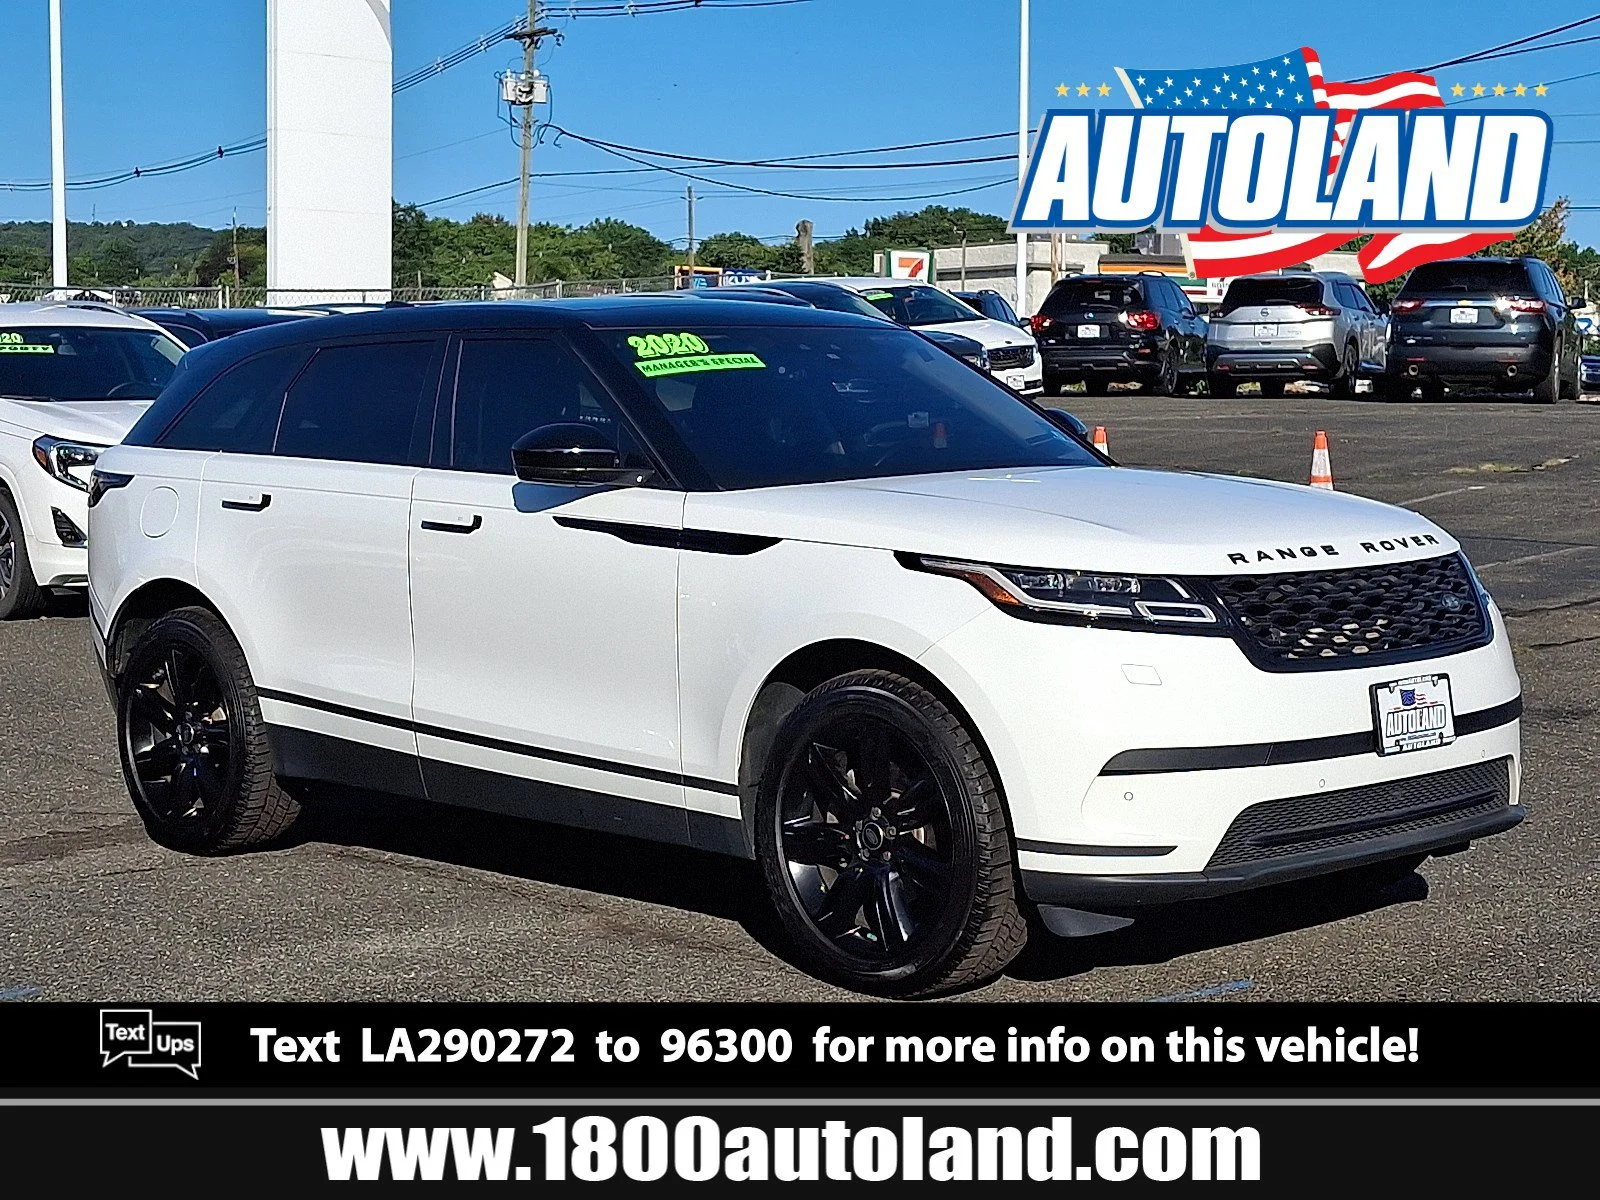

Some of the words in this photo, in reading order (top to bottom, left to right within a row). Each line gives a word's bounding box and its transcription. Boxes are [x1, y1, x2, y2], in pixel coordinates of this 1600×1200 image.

[898, 256, 924, 278] 7
[627, 332, 709, 358] 2020
[640, 358, 710, 373] MANAGER'S
[711, 356, 759, 366] SPECIAL
[1227, 545, 1339, 565] RANGE
[1360, 534, 1440, 553] ROVER
[1385, 704, 1447, 738] AUTOLAND
